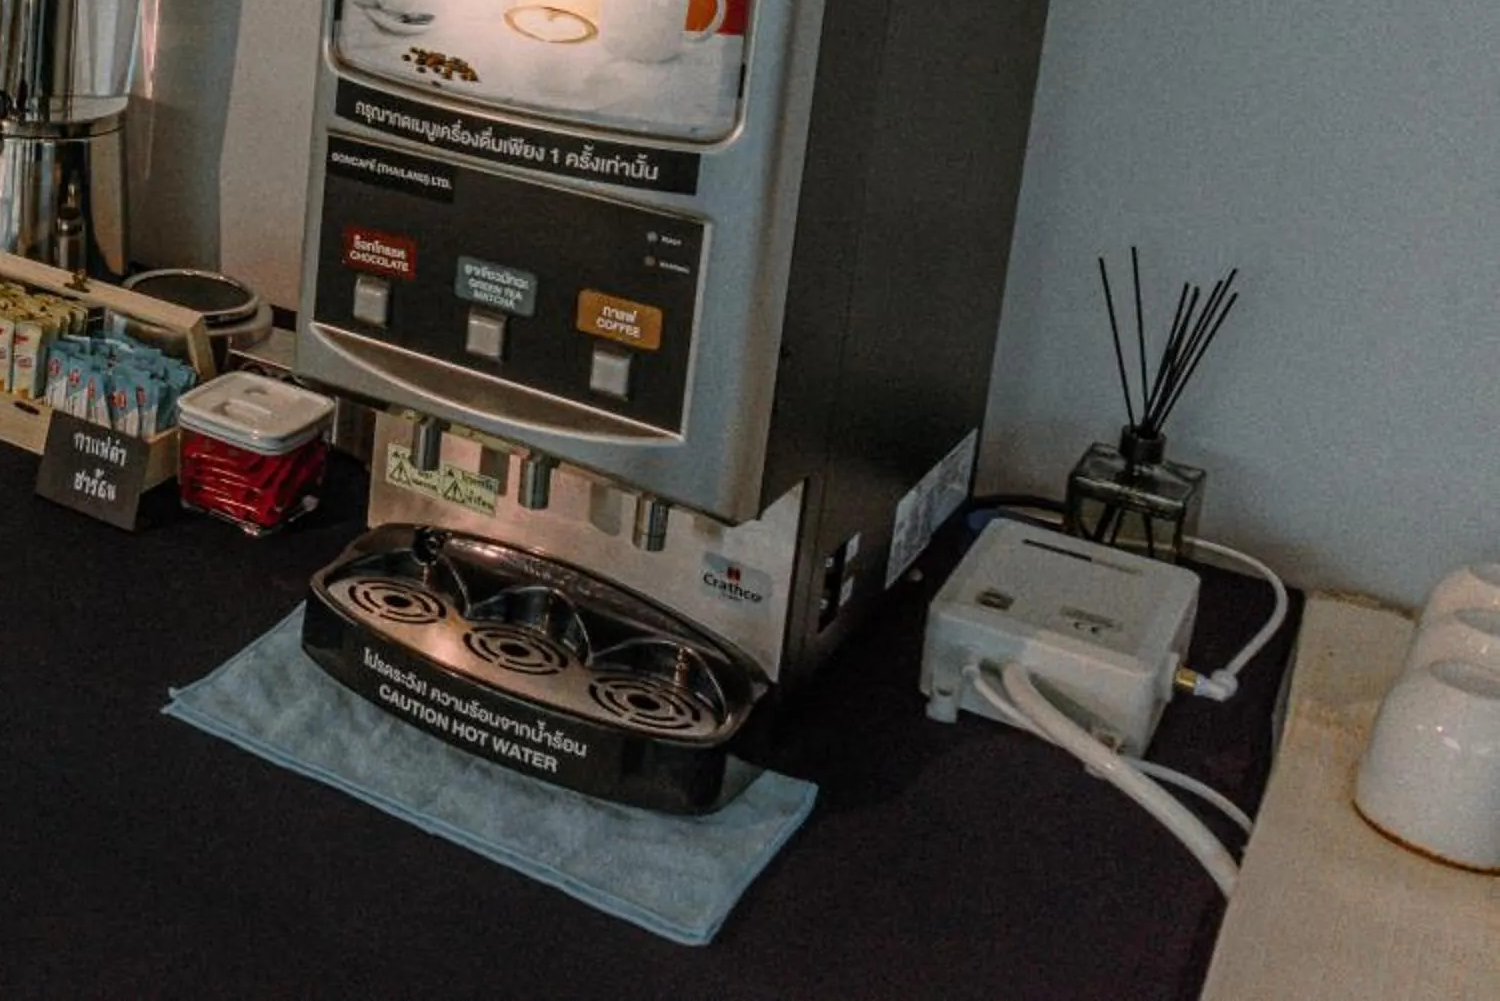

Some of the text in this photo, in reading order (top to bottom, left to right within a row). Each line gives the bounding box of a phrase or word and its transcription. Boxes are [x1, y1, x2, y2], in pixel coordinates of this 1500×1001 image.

[551, 148, 559, 163] 1
[350, 250, 409, 272] CHOCOLATE
[596, 317, 641, 338] COFFEE
[703, 572, 763, 603] Crathco
[379, 684, 557, 773] CAUTION HOT WATER
